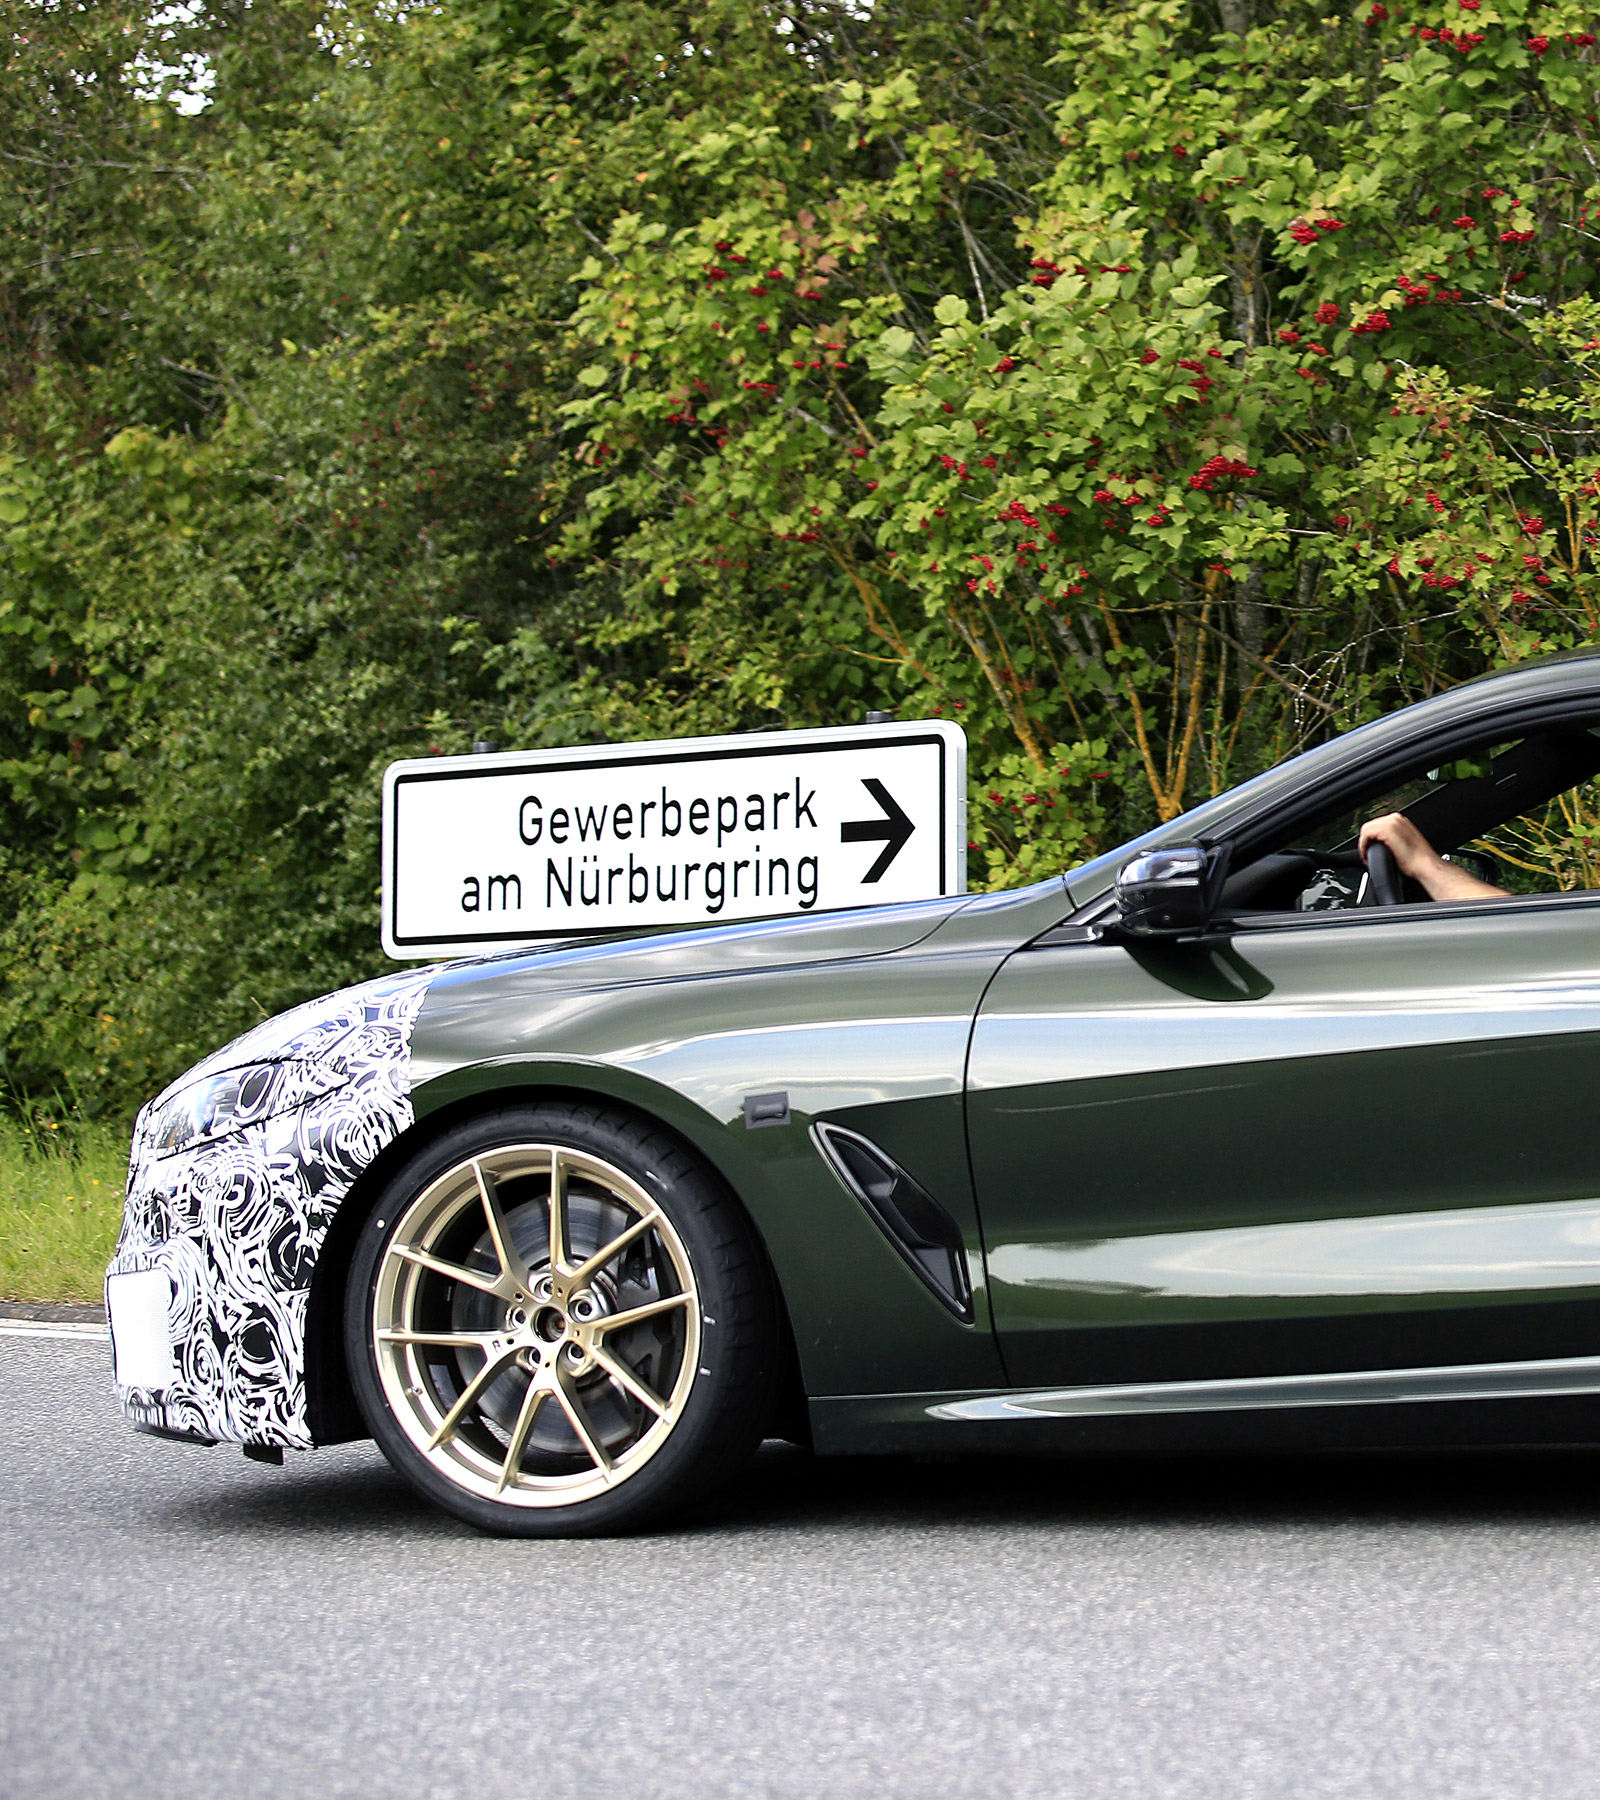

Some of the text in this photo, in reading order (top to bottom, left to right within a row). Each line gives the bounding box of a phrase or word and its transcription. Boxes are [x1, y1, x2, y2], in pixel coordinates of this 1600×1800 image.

[518, 776, 818, 848] Gewerbepark
[461, 844, 819, 914] am Nürburgring
